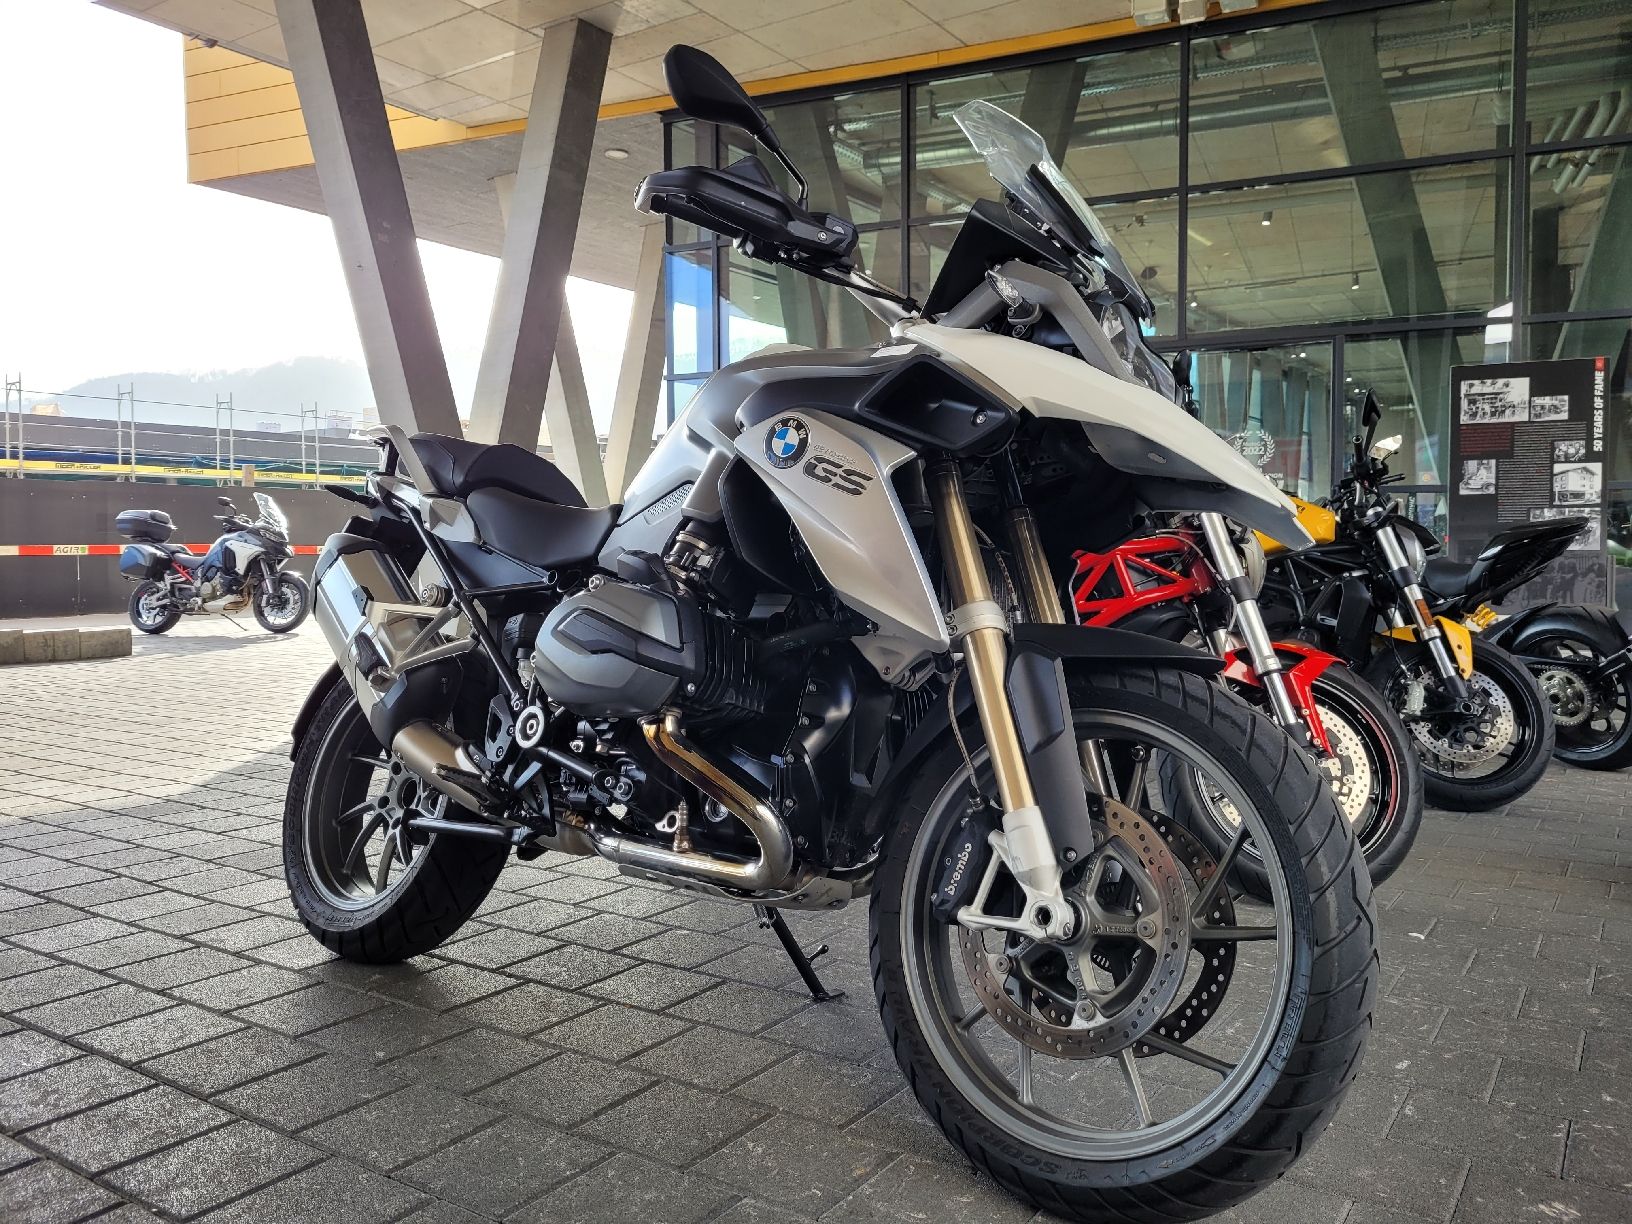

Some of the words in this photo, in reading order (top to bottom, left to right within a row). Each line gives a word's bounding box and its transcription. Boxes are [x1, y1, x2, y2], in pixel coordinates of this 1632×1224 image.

[1594, 370, 1604, 396] FAME
[1594, 396, 1604, 409] OF
[774, 419, 807, 439] BMW
[1594, 409, 1603, 439] YEARS
[1242, 446, 1265, 455] 2022
[1593, 440, 1603, 452] 50
[803, 455, 876, 497] GS
[54, 546, 80, 554] AGIR
[944, 842, 972, 896] brembo
